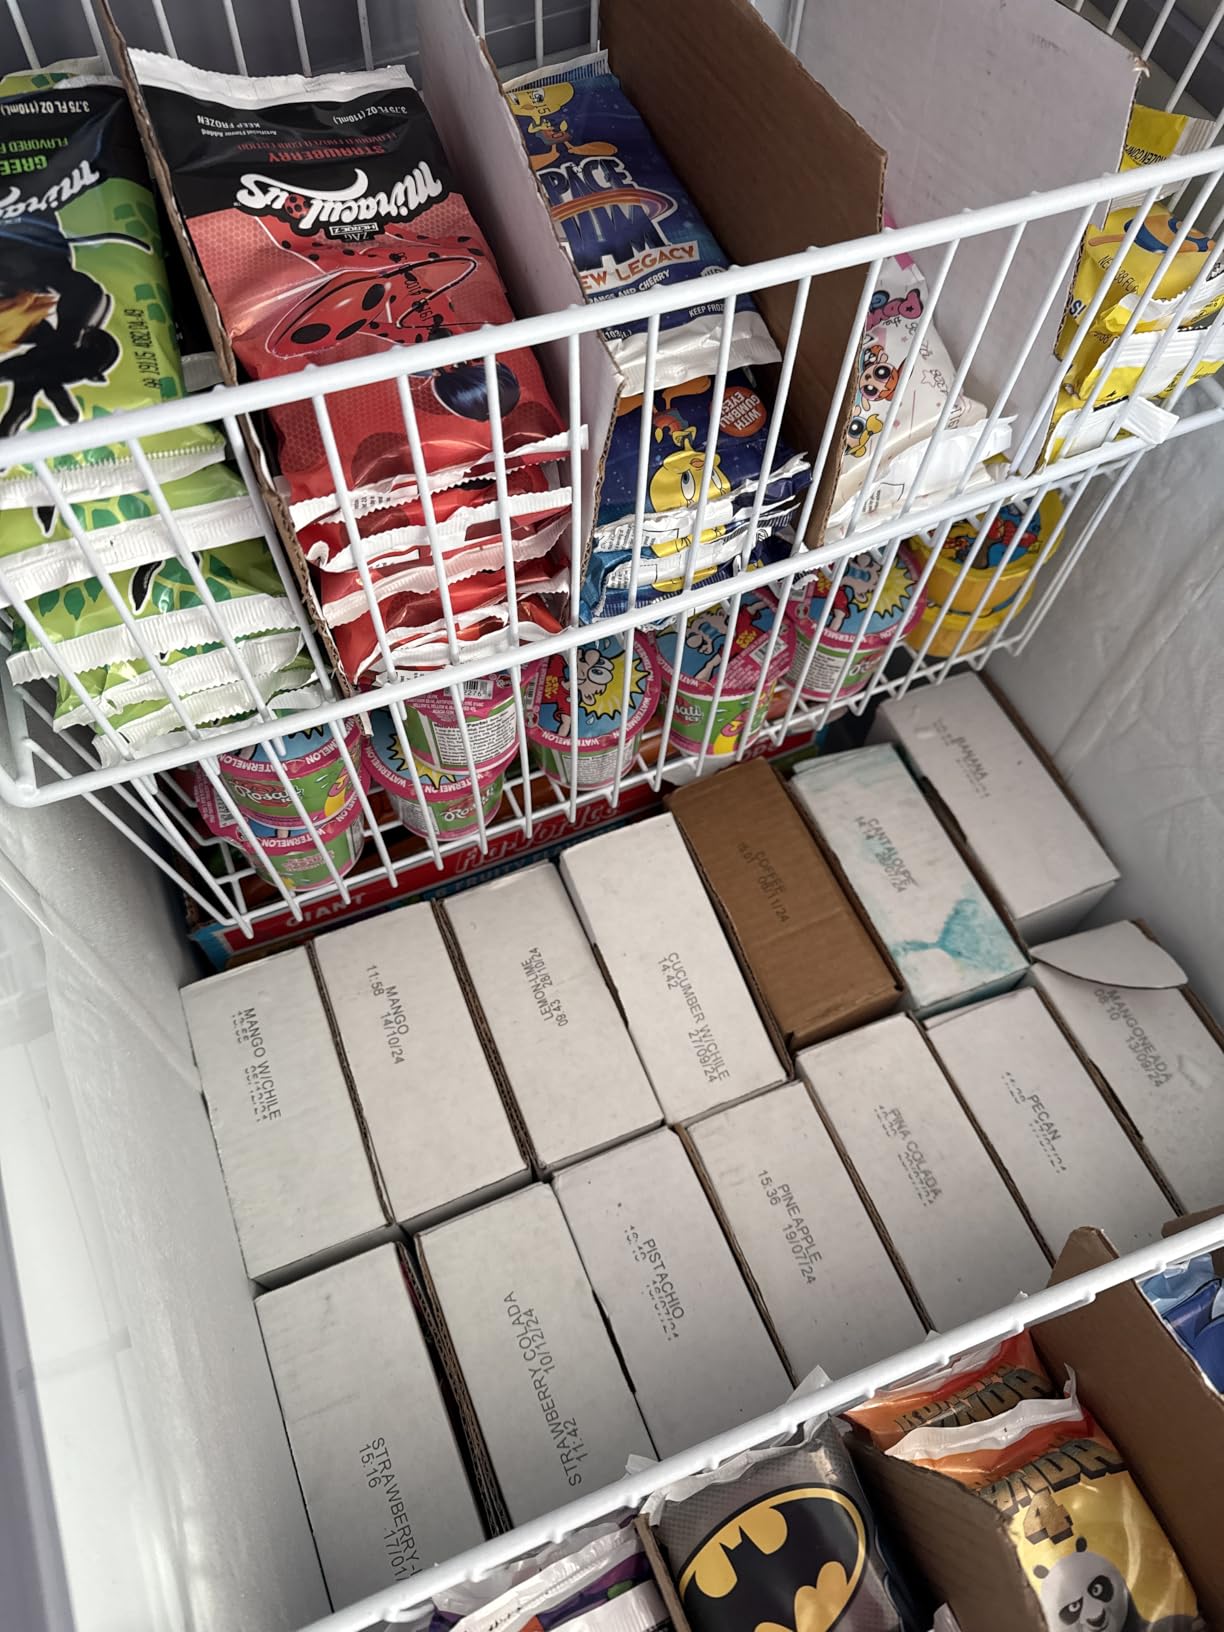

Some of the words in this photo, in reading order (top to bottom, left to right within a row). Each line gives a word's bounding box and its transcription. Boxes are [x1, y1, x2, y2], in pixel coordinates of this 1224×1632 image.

[41, 101, 57, 113] OZ
[58, 101, 69, 113] FL
[69, 100, 91, 114] 3.75
[197, 115, 235, 129] FROZEN
[0, 154, 48, 176] GREE
[9, 137, 69, 152] FLAVORED
[269, 145, 385, 163] STRAWBERRY
[0, 159, 100, 219] Mira
[539, 156, 635, 206] PACE
[578, 271, 608, 291] EW
[615, 245, 695, 282] LEGACY
[638, 269, 671, 292] CHERRY
[688, 305, 707, 318] KEEP
[707, 303, 727, 314] FROZ
[882, 316, 903, 329] the
[734, 409, 762, 430] WITH
[366, 965, 385, 997] 11:58
[520, 958, 554, 1022] LEMON-LIME
[657, 957, 679, 991] 14:42
[667, 952, 706, 1024] CUCUMBER
[384, 985, 410, 1035] MANGO
[688, 1028, 718, 1083] 27/09/24
[699, 1024, 730, 1081] W/CHILE
[1106, 989, 1173, 1084] MANGONEADA
[243, 1007, 267, 1058] MANGO
[257, 1060, 282, 1121] W/CHILE
[1027, 1094, 1062, 1141] PECAN
[906, 1140, 943, 1200] COLADA
[758, 1169, 782, 1206] 15:36
[782, 1223, 817, 1285] 19/07/24
[777, 1183, 823, 1264] PINEAPPLE
[642, 1237, 685, 1320] PISTACHIO
[504, 1291, 537, 1362] COLADA
[522, 1307, 556, 1374] 10/12/24
[528, 1367, 583, 1487] STRAWBERRY
[562, 1417, 590, 1462] 11:42
[976, 1438, 1129, 1517] ANDA
[359, 1443, 382, 1489] 15:16
[383, 1530, 411, 1582] 17/01/
